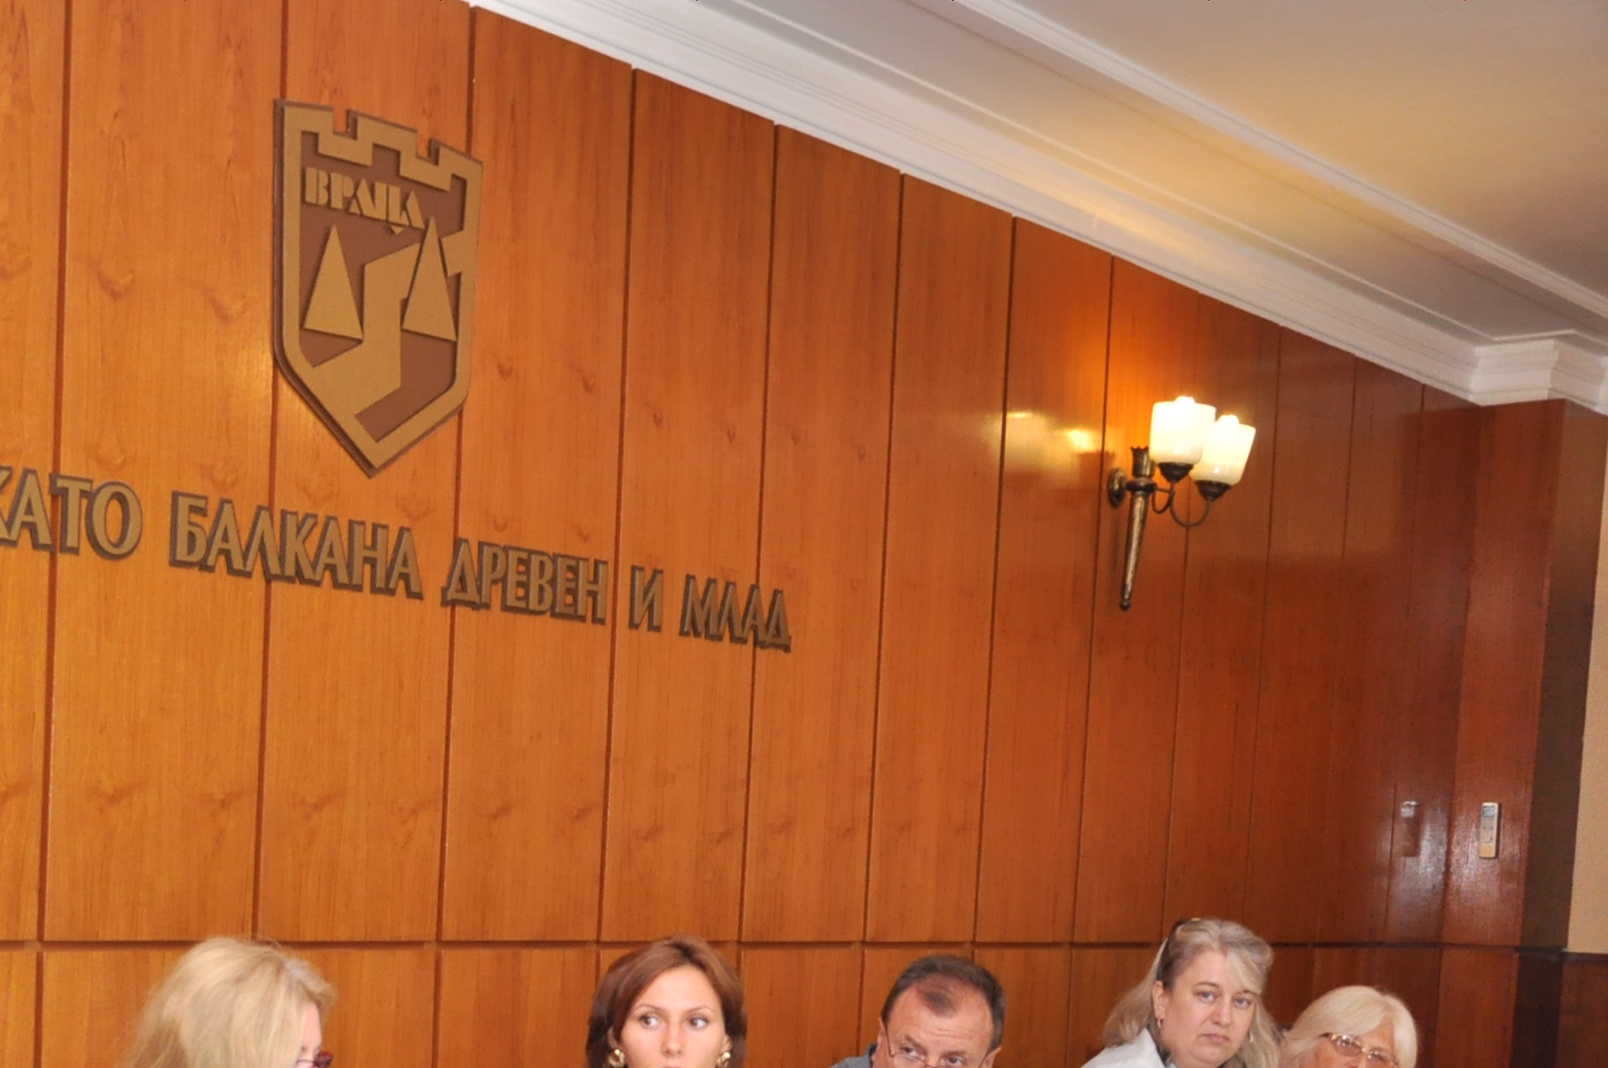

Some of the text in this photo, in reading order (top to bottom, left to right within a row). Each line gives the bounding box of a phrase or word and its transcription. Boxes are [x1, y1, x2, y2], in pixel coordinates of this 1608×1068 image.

[303, 165, 426, 235] ВРАЦА
[169, 490, 423, 600] БАЛКАНА
[441, 537, 608, 625] ДРЕВЕН
[628, 565, 663, 633] И
[679, 574, 791, 652] МЛАД
